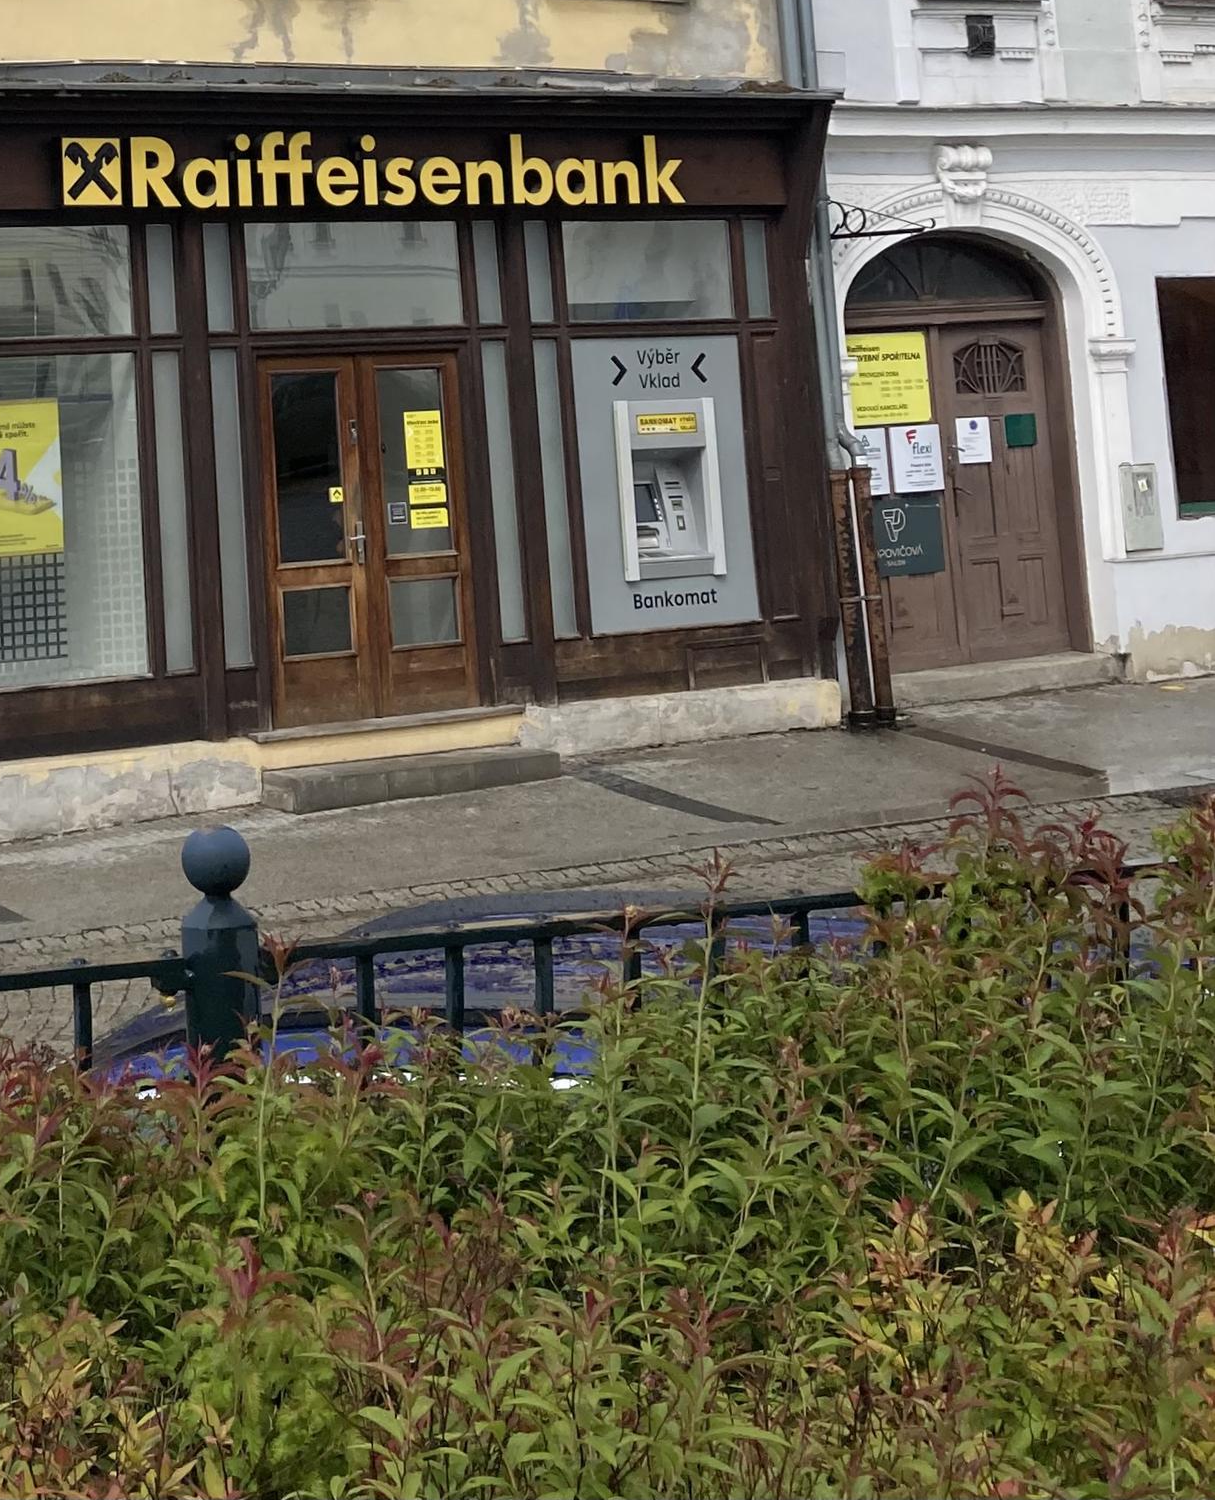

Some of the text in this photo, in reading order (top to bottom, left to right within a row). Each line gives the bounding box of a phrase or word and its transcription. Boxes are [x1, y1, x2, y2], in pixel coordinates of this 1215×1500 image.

[129, 131, 686, 208] Raiffeisenbank
[637, 348, 680, 369] Výběr
[639, 372, 680, 389] Vklad
[912, 441, 933, 455] flexi
[877, 543, 924, 559] POVIČOVÁ
[633, 588, 718, 610] Bankomat
